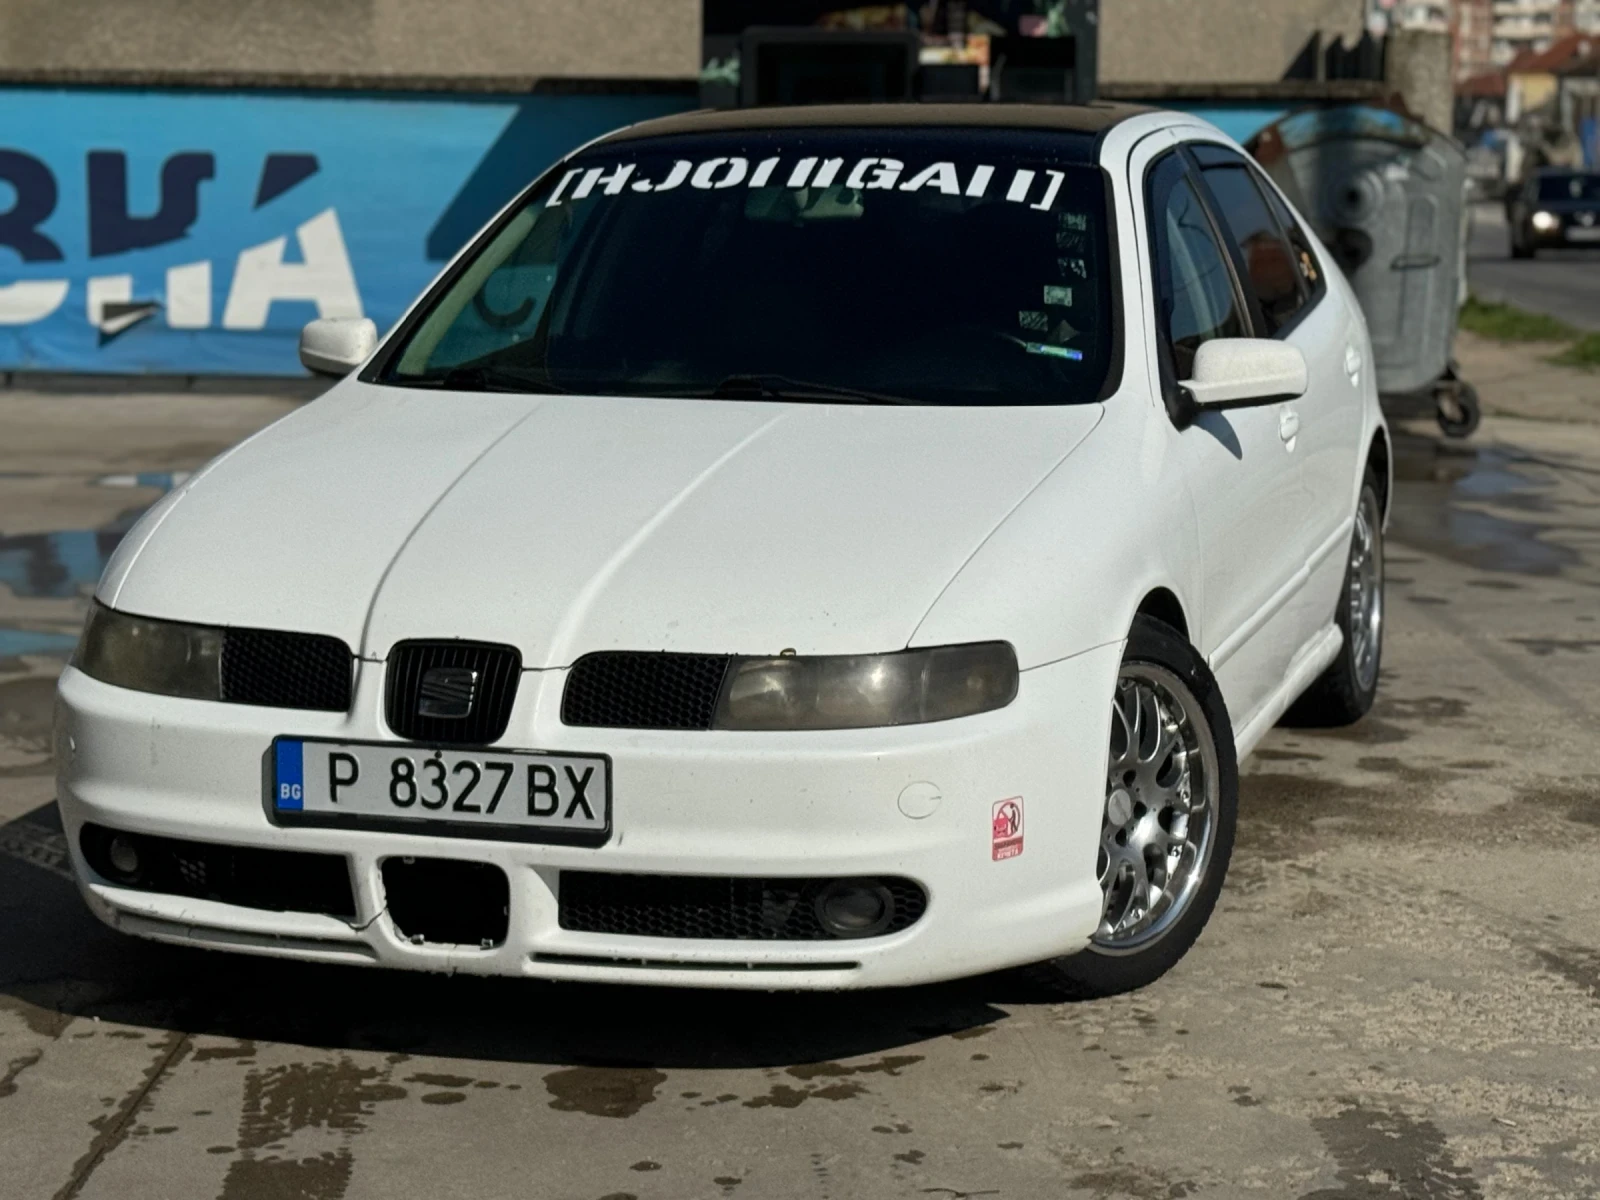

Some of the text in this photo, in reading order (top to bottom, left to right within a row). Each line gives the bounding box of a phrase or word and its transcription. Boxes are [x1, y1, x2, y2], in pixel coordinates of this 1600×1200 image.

[281, 783, 302, 800] BG
[328, 752, 595, 820] P 8327 BX
